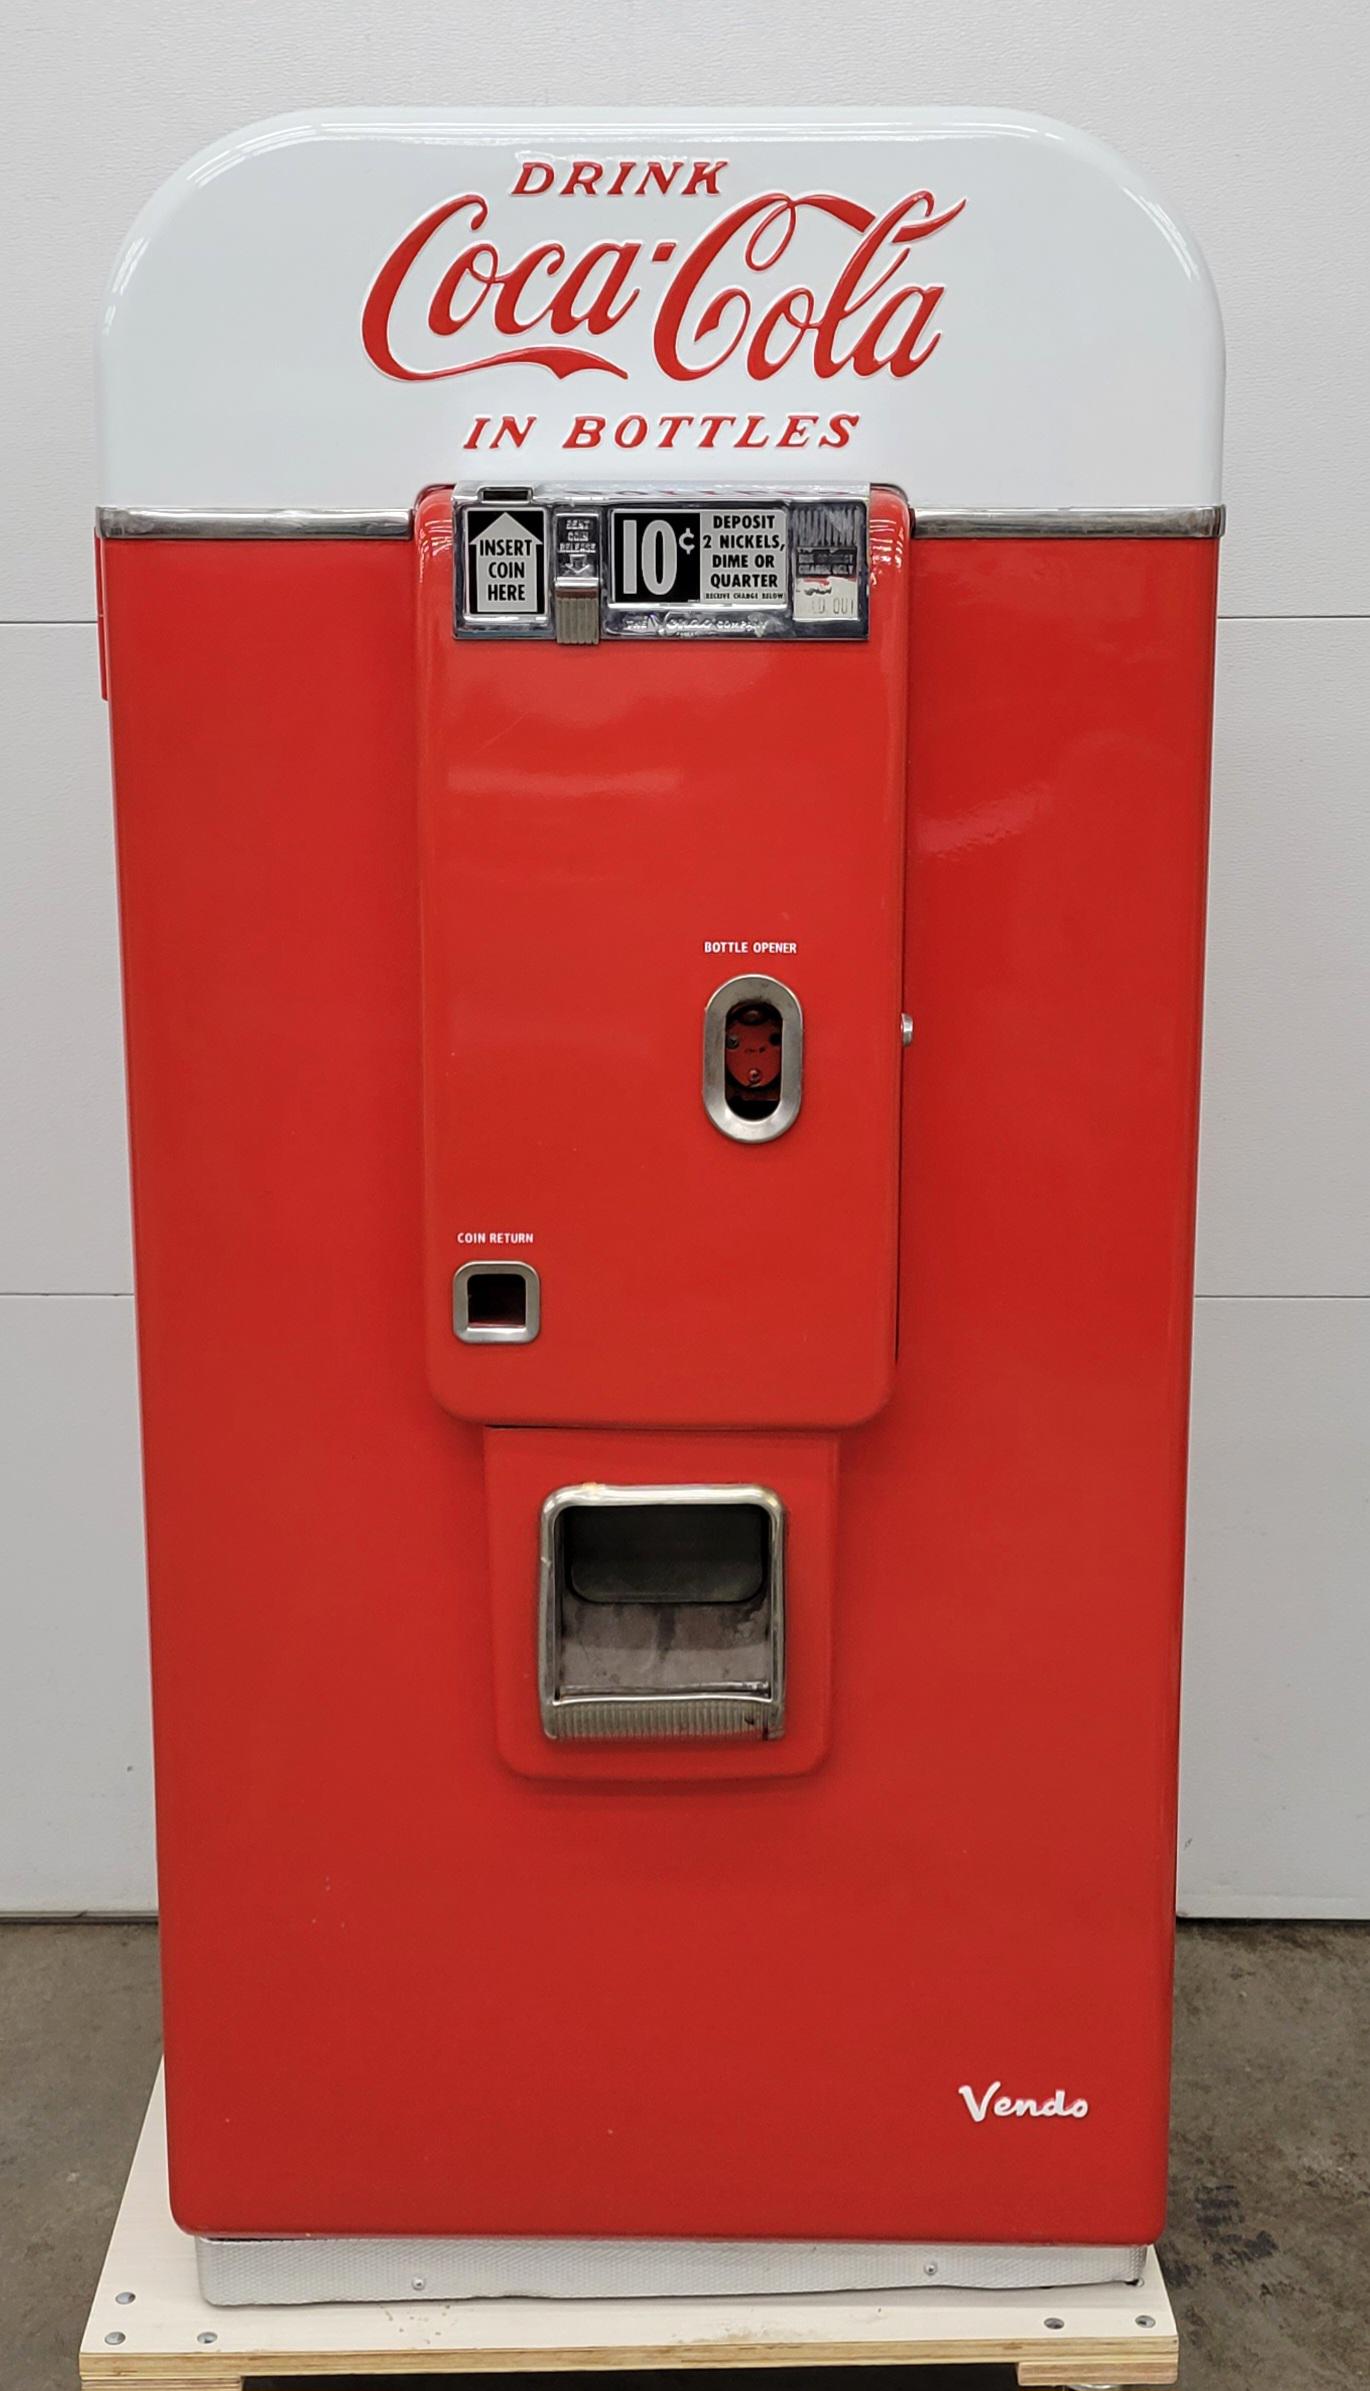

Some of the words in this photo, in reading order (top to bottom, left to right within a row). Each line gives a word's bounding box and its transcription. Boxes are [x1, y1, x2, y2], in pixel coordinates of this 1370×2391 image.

[511, 160, 728, 196] DRINK
[361, 190, 967, 382] Coca-Cola
[463, 416, 537, 449] IN
[562, 415, 861, 448] BOTTLES
[713, 514, 775, 529] DEPOSIT
[479, 539, 532, 557] INSERT
[703, 535, 712, 549] 2
[720, 535, 785, 552] NICKELS,
[488, 561, 525, 579] COIN
[712, 553, 748, 569] DIME
[754, 553, 775, 569] OR
[710, 573, 778, 590] QUARTER
[487, 584, 526, 602] HERE
[704, 941, 748, 954] BOTTLE
[752, 941, 797, 954] OPENER
[457, 1232, 486, 1244] COIN
[489, 1232, 534, 1244] RETURN
[958, 2080, 1088, 2123] Vendo
